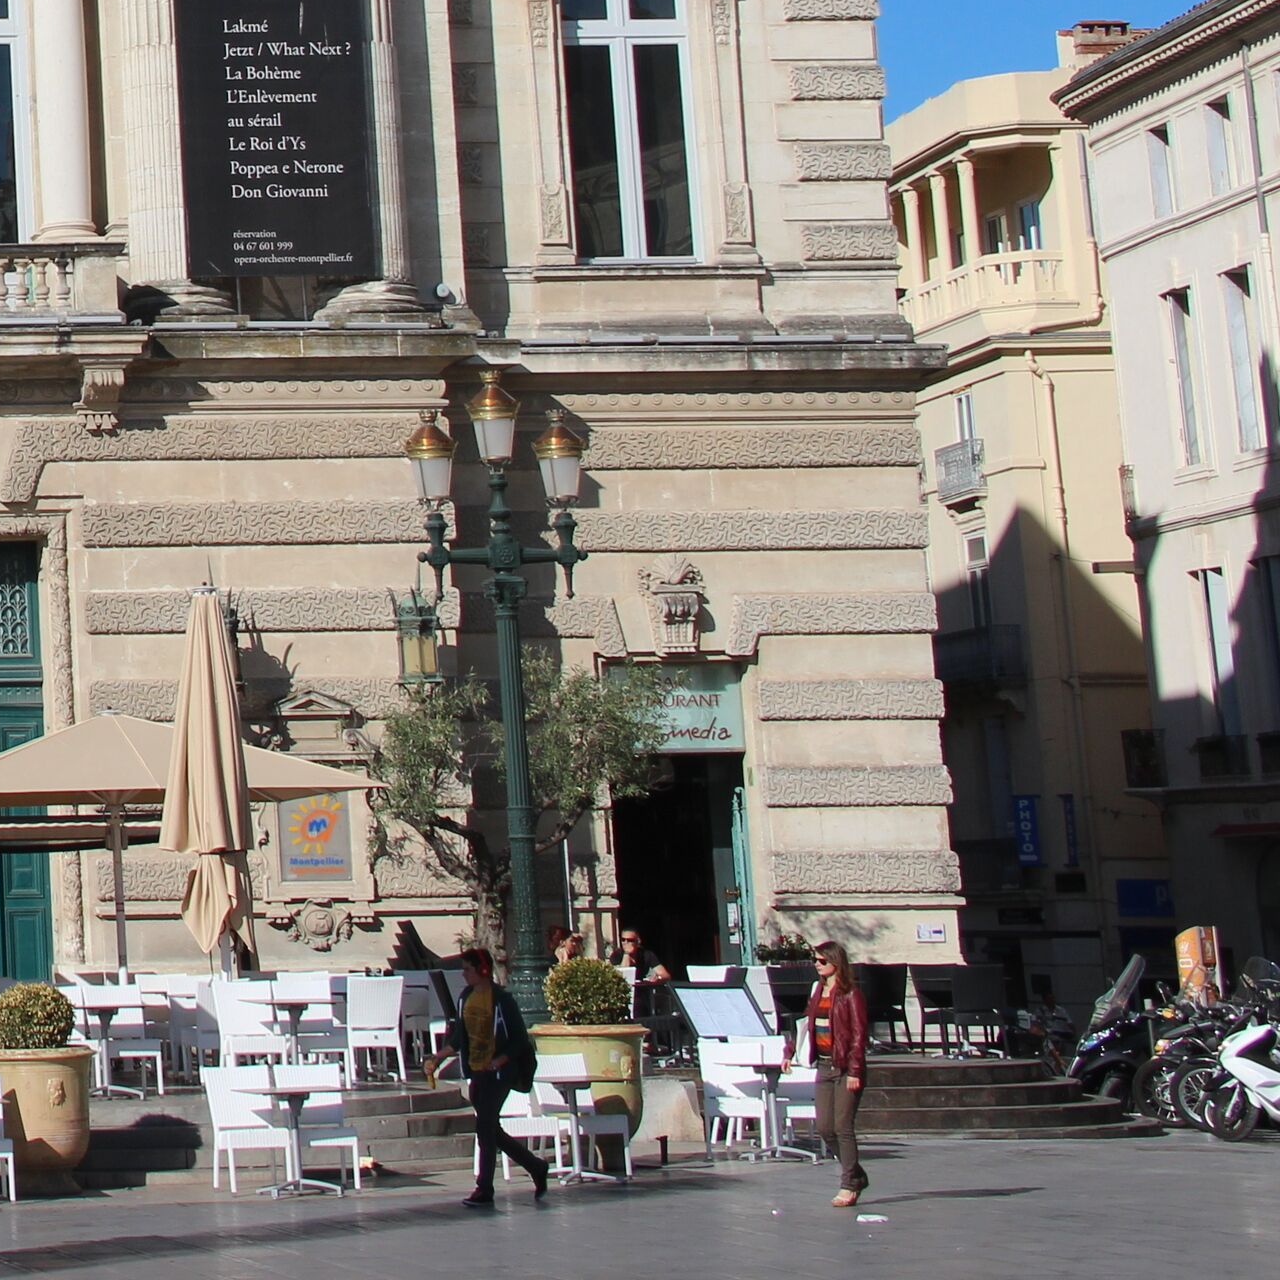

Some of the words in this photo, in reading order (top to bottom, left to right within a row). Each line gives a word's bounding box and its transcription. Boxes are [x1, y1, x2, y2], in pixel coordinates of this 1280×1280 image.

[223, 19, 269, 33] Lakmé
[223, 42, 254, 60] Jetzt
[267, 41, 305, 56] What
[308, 41, 342, 56] Next
[225, 66, 242, 80] La
[246, 65, 301, 80] Bohème
[226, 89, 318, 104] L'Enlèvement
[227, 116, 243, 127] au
[247, 113, 281, 127] sérail
[228, 136, 246, 151] Le
[250, 136, 273, 151] Roi
[230, 161, 278, 179] Poppea
[282, 164, 290, 174] e
[294, 160, 344, 174] Nerone
[231, 184, 262, 199] Don
[266, 183, 329, 199] Giovanni
[233, 229, 277, 239] réservation
[233, 242, 244, 251] 04
[246, 242, 257, 251] 67
[258, 241, 274, 251] 601
[276, 241, 293, 251] 999
[234, 252, 353, 265] opera-orchestre-montpellier.fr
[1018, 800, 1035, 853] PHOTO
